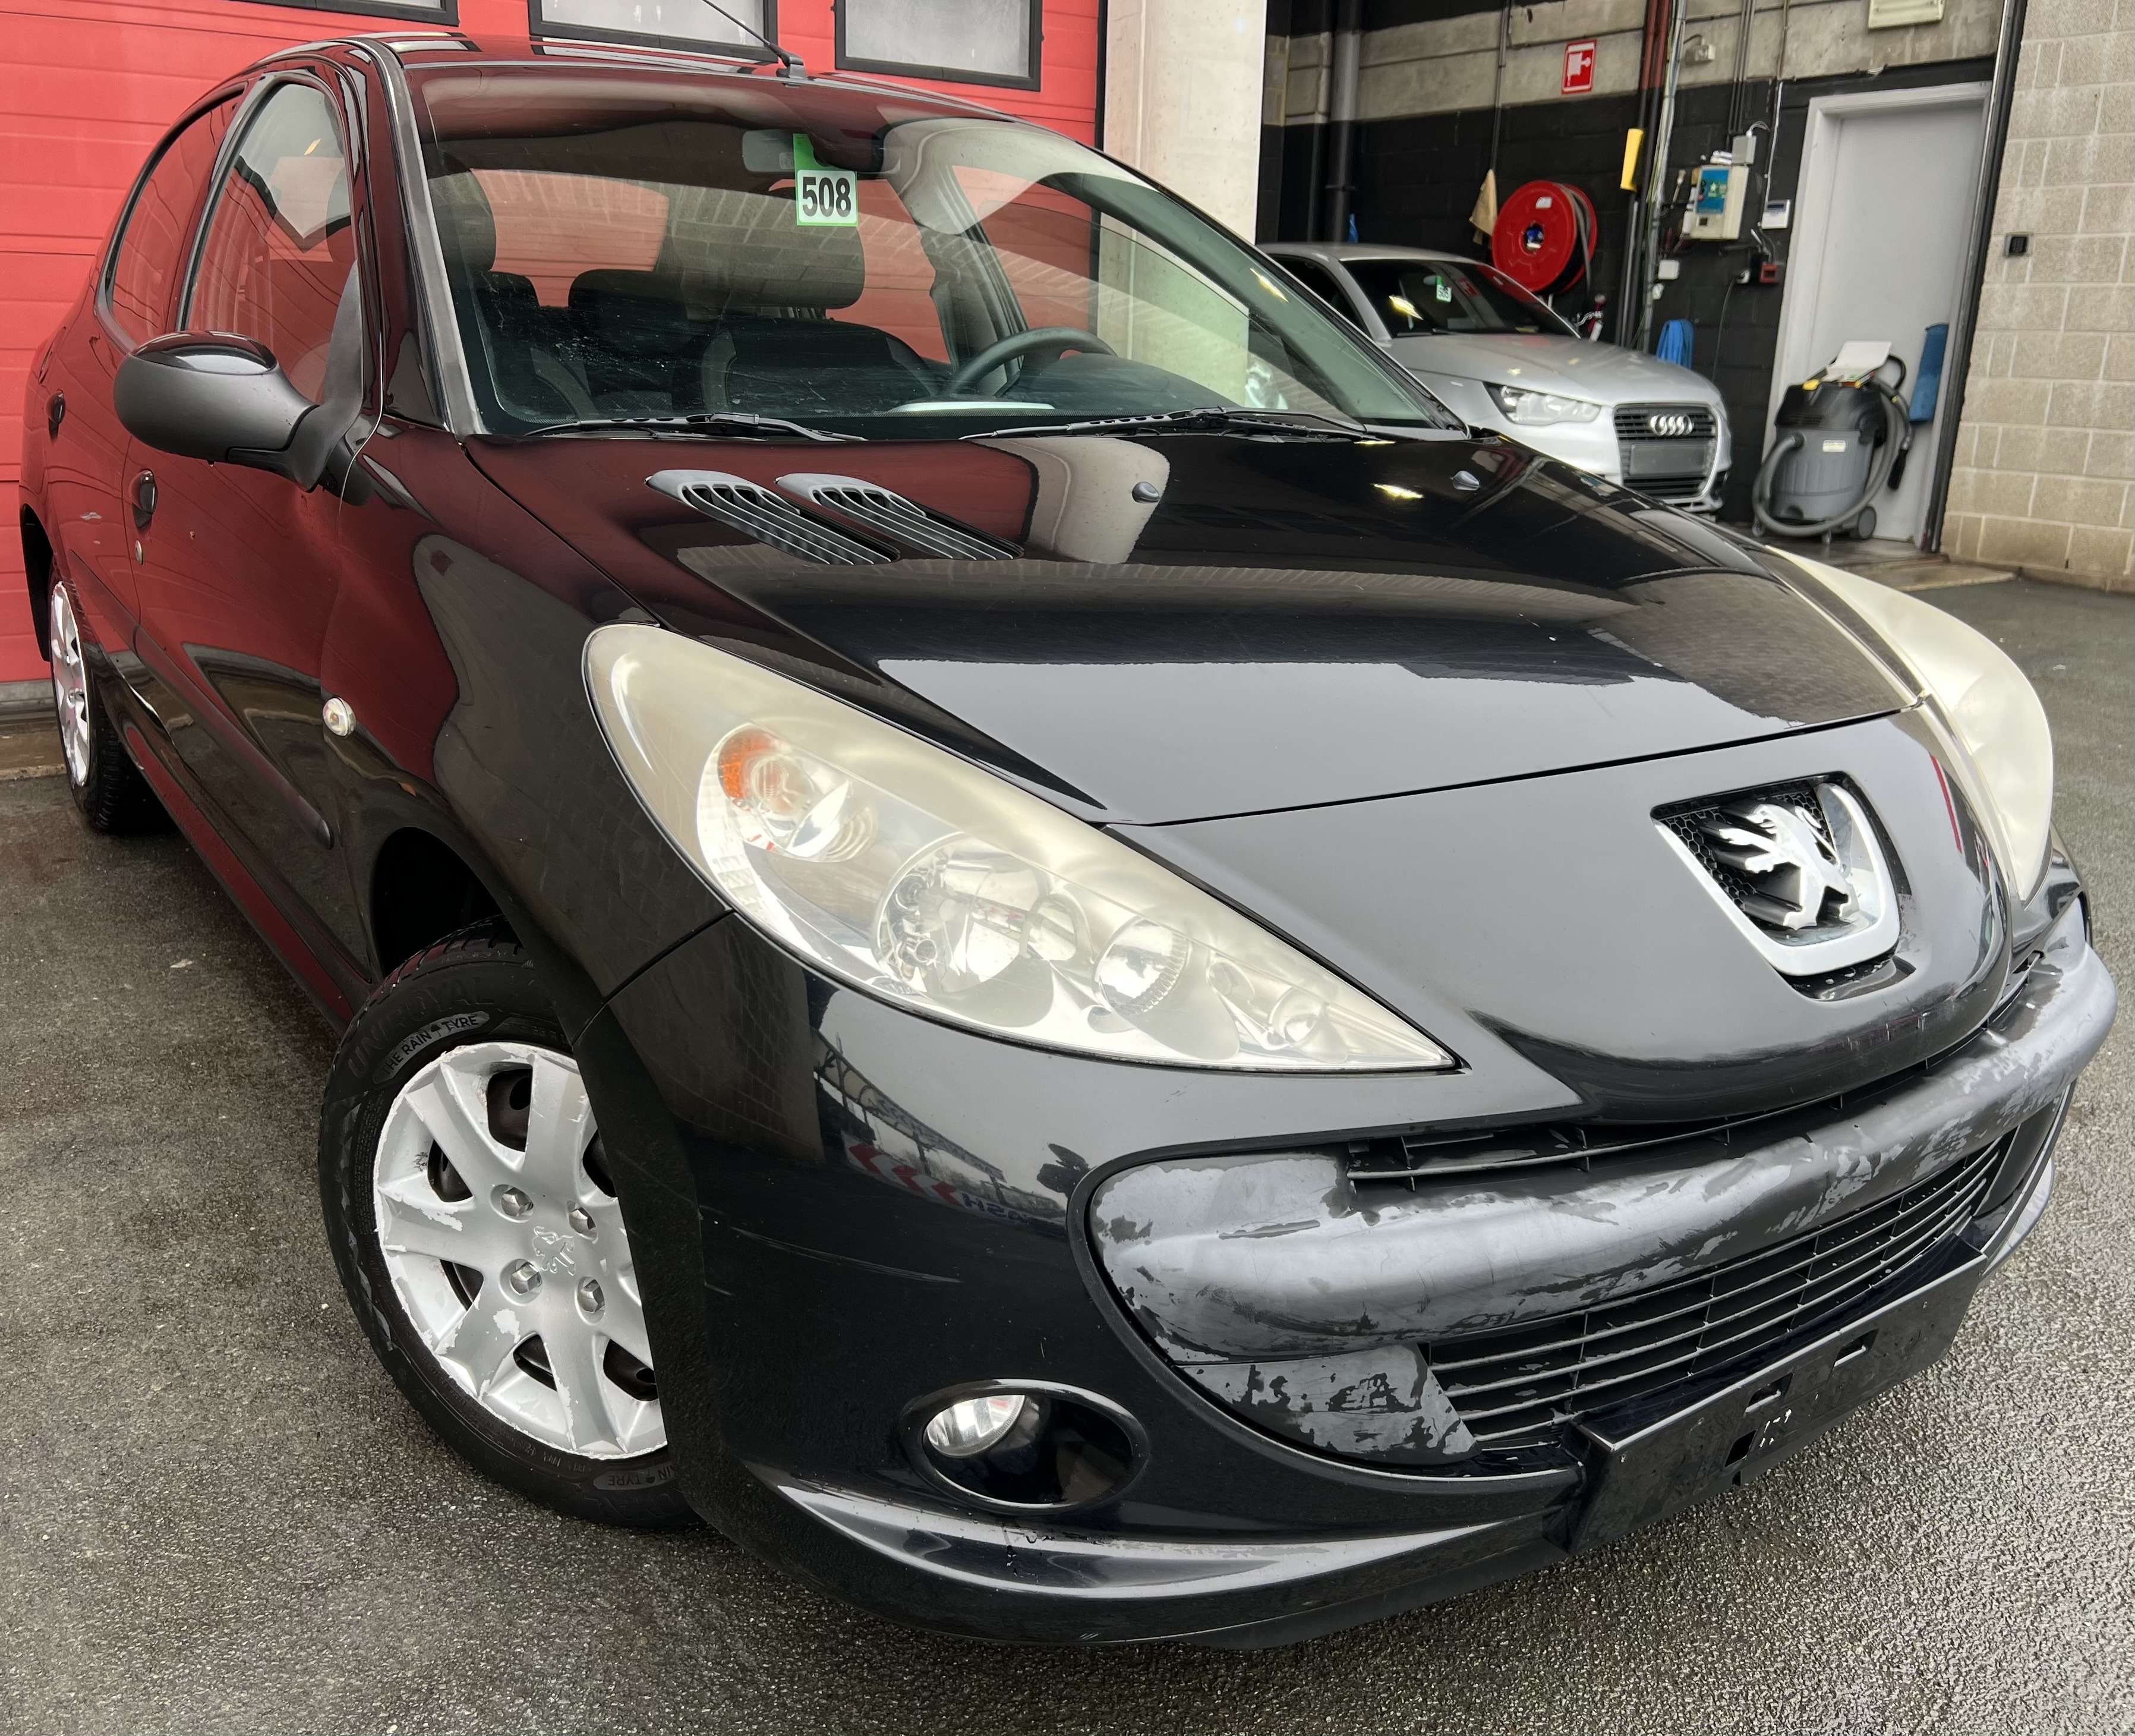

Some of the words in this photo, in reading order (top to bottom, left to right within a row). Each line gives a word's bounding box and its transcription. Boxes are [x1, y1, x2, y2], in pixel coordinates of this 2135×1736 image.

[802, 176, 852, 218] 508
[382, 1054, 404, 1076] THE
[403, 1031, 433, 1056] RAIN
[441, 1014, 479, 1032] TYRE
[607, 1474, 643, 1486] TYRE
